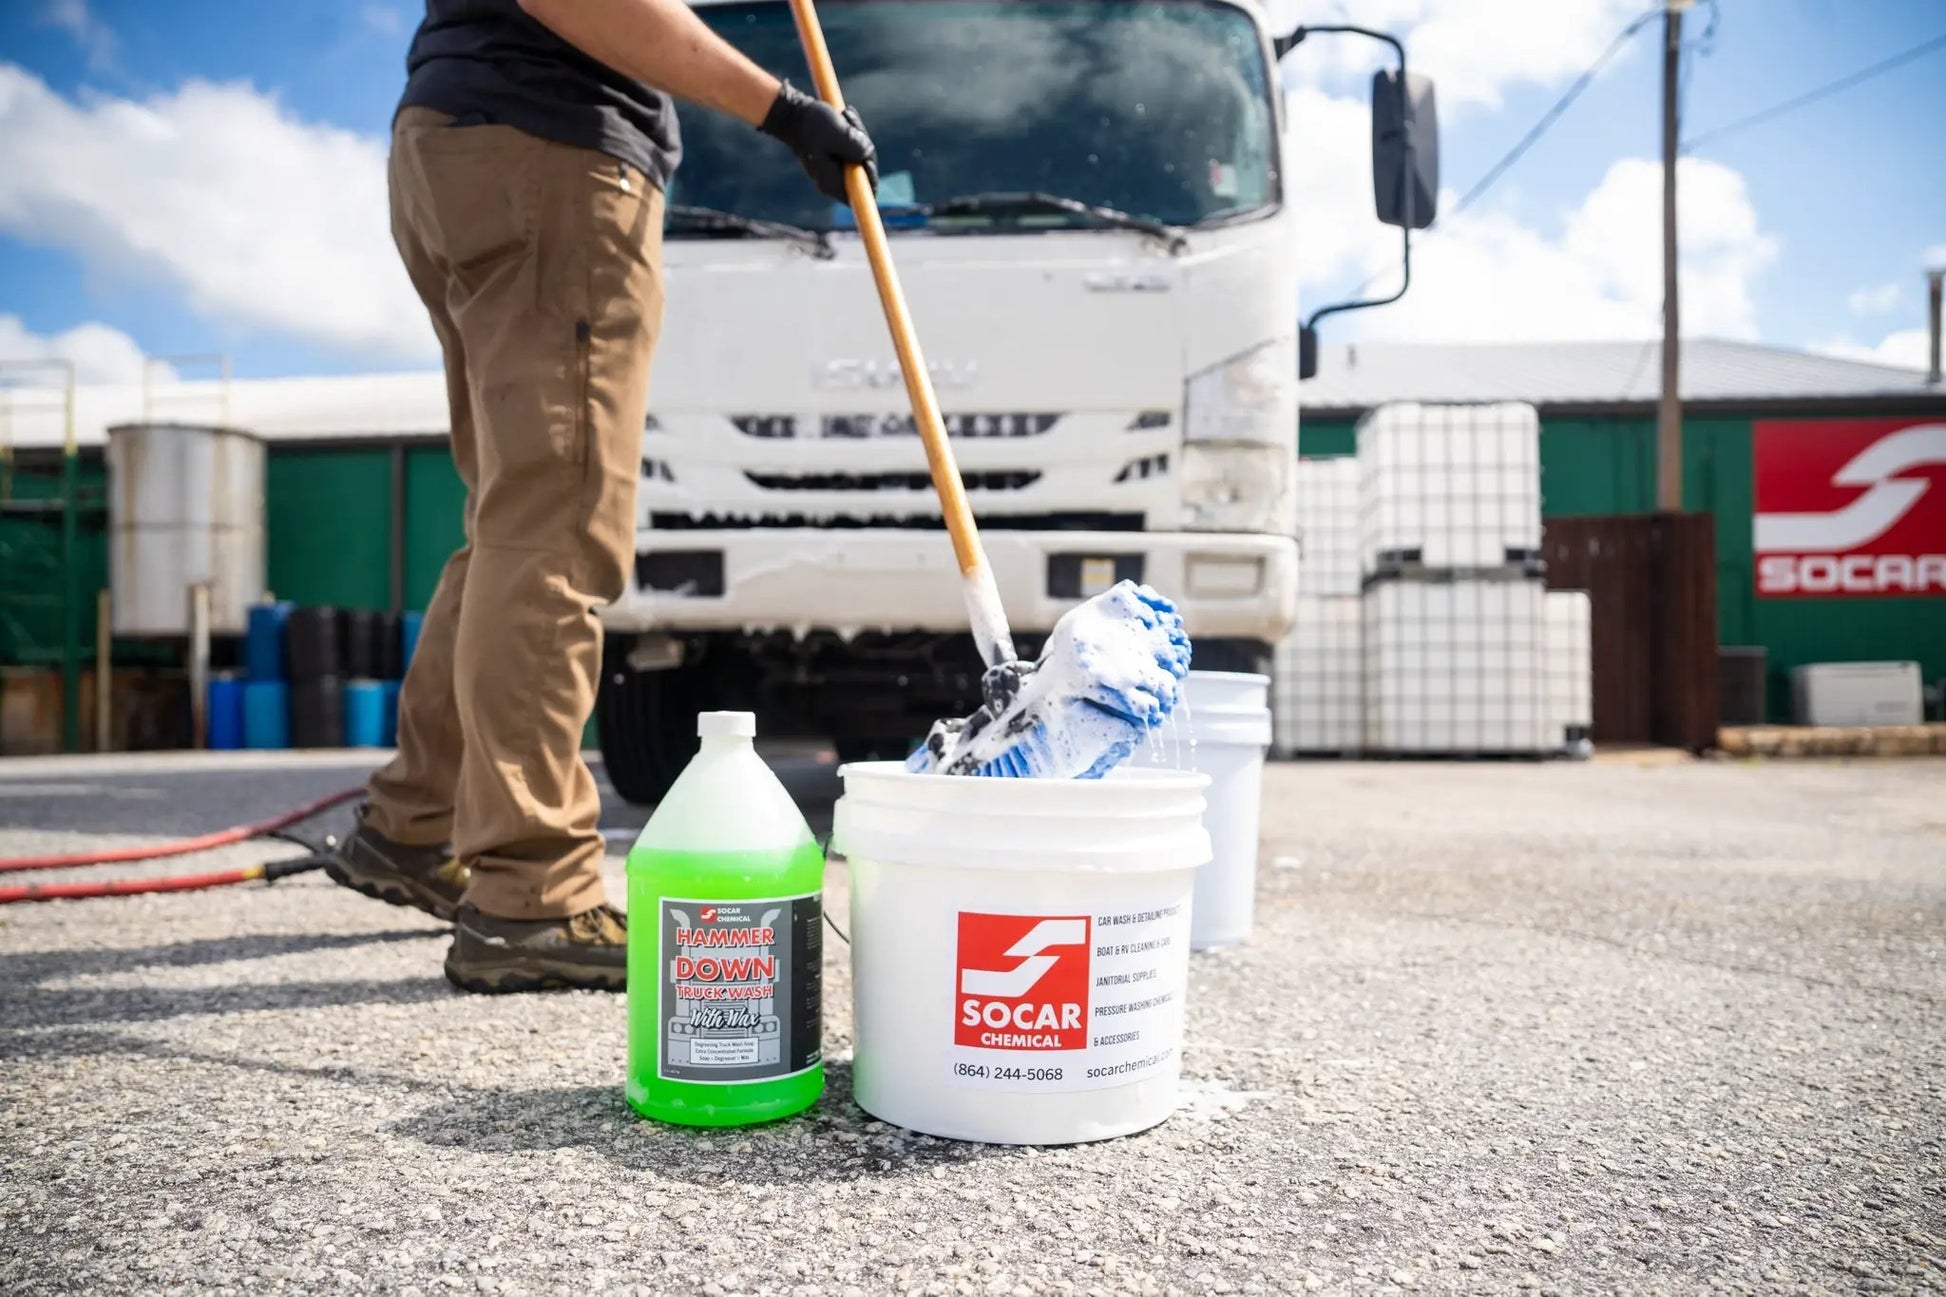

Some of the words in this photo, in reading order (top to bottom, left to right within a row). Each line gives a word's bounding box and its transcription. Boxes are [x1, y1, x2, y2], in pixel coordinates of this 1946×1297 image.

[810, 358, 979, 392] ISUU
[1758, 554, 1946, 592] SOCAR
[1098, 916, 1112, 926] CAR
[1113, 914, 1131, 925] WASH
[676, 927, 775, 947] HAMMER
[1097, 946, 1114, 957] BOAT
[1121, 944, 1130, 954] RV
[675, 955, 775, 981] DOWN
[1096, 974, 1131, 987] JANITORIAL
[1132, 969, 1157, 982] SUPPLIES
[676, 984, 724, 1000] TRUCK
[728, 984, 774, 1000] WASH
[690, 1007, 725, 1028] With
[725, 1007, 761, 1028] Wax
[962, 999, 1082, 1030] SOCAR
[1095, 1004, 1127, 1016] PRESSURE
[980, 1032, 1062, 1048] CHEMICAL
[1100, 1030, 1140, 1046] ACCESSORIES
[953, 1062, 990, 1079] (864)
[994, 1066, 1063, 1081] 244-5068
